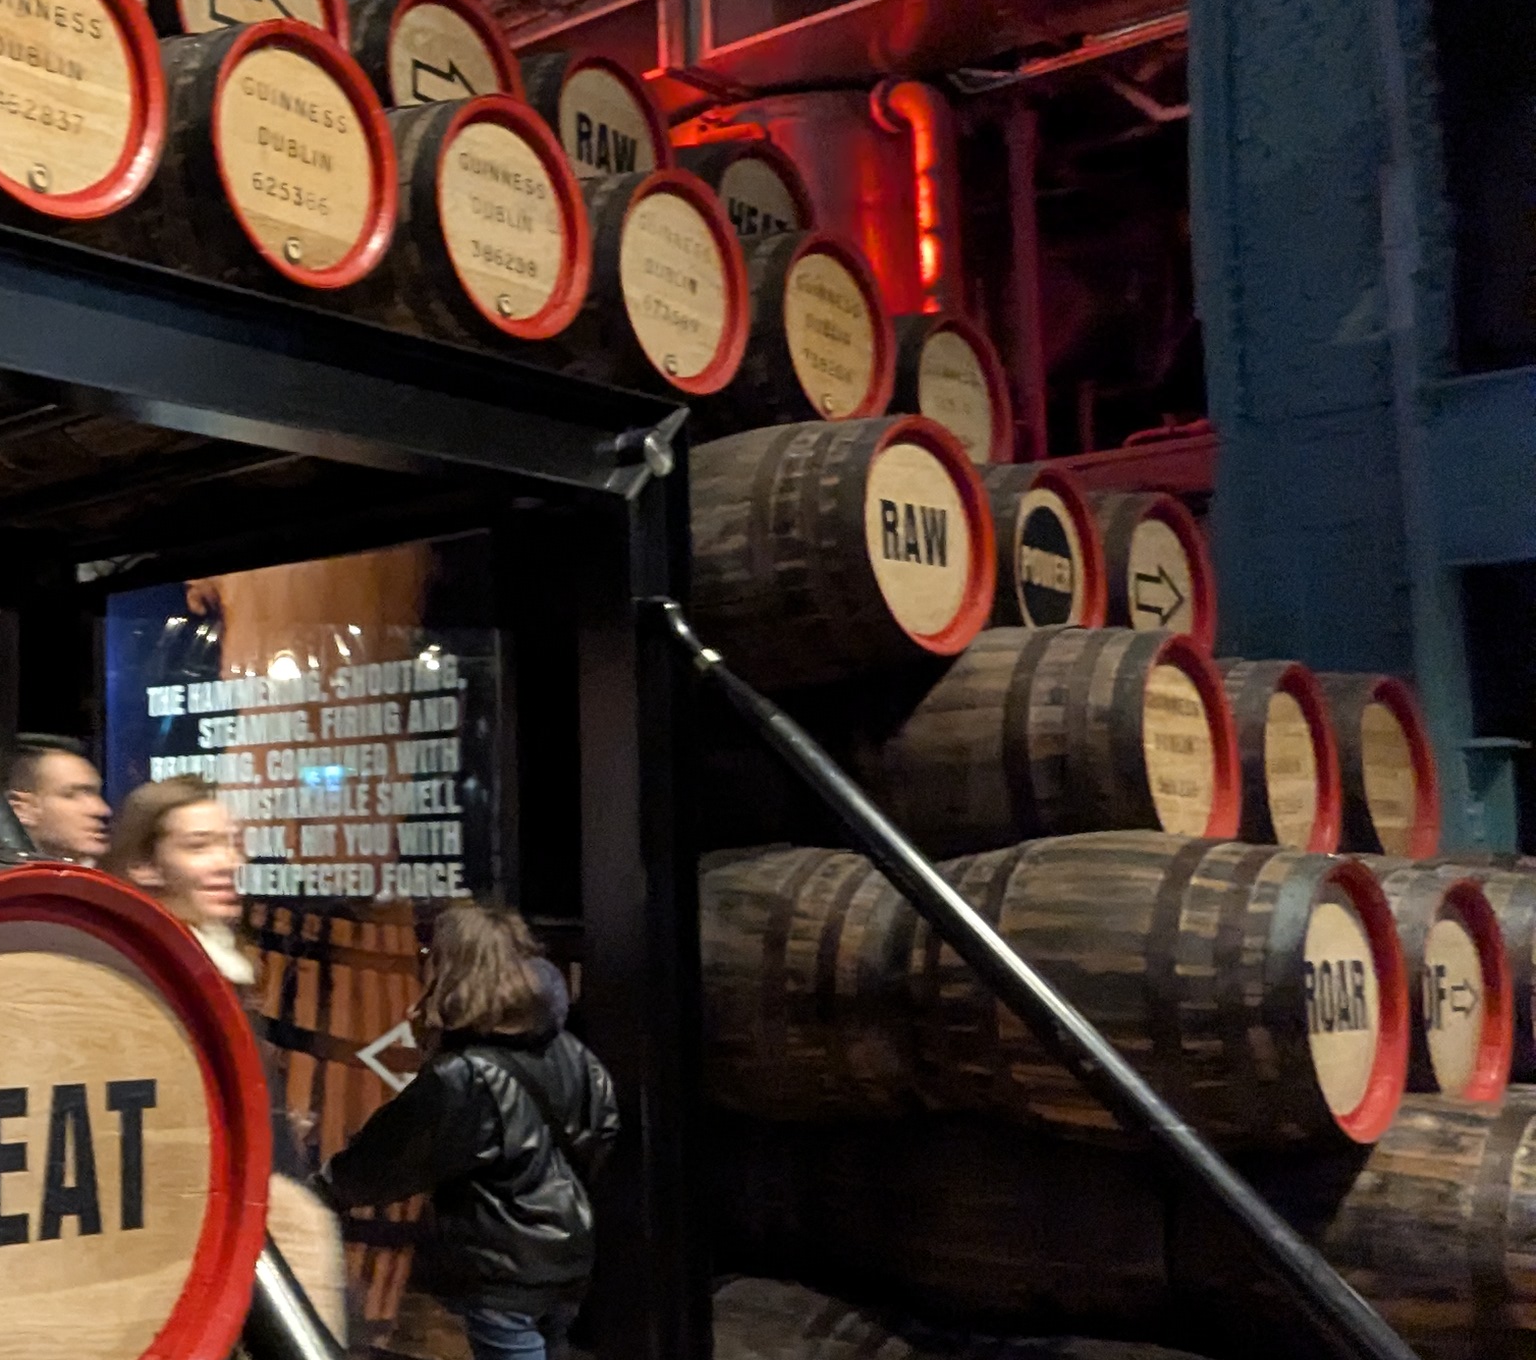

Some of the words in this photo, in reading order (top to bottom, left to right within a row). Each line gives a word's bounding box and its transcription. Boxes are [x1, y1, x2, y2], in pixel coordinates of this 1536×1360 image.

[241, 76, 347, 134] GUINNESS
[257, 125, 333, 173] DUBLIN
[576, 111, 638, 173] RAW
[459, 151, 546, 200] GUINNESS
[728, 197, 789, 235] HE
[879, 498, 948, 568] RAW
[147, 684, 186, 718] THE
[320, 701, 402, 740] FIRING
[407, 696, 460, 733] AND
[395, 736, 461, 774] WITH
[376, 779, 463, 816] SMELL
[342, 822, 391, 857] YOU
[396, 820, 462, 856] WITH
[1303, 959, 1369, 1034] ROAR
